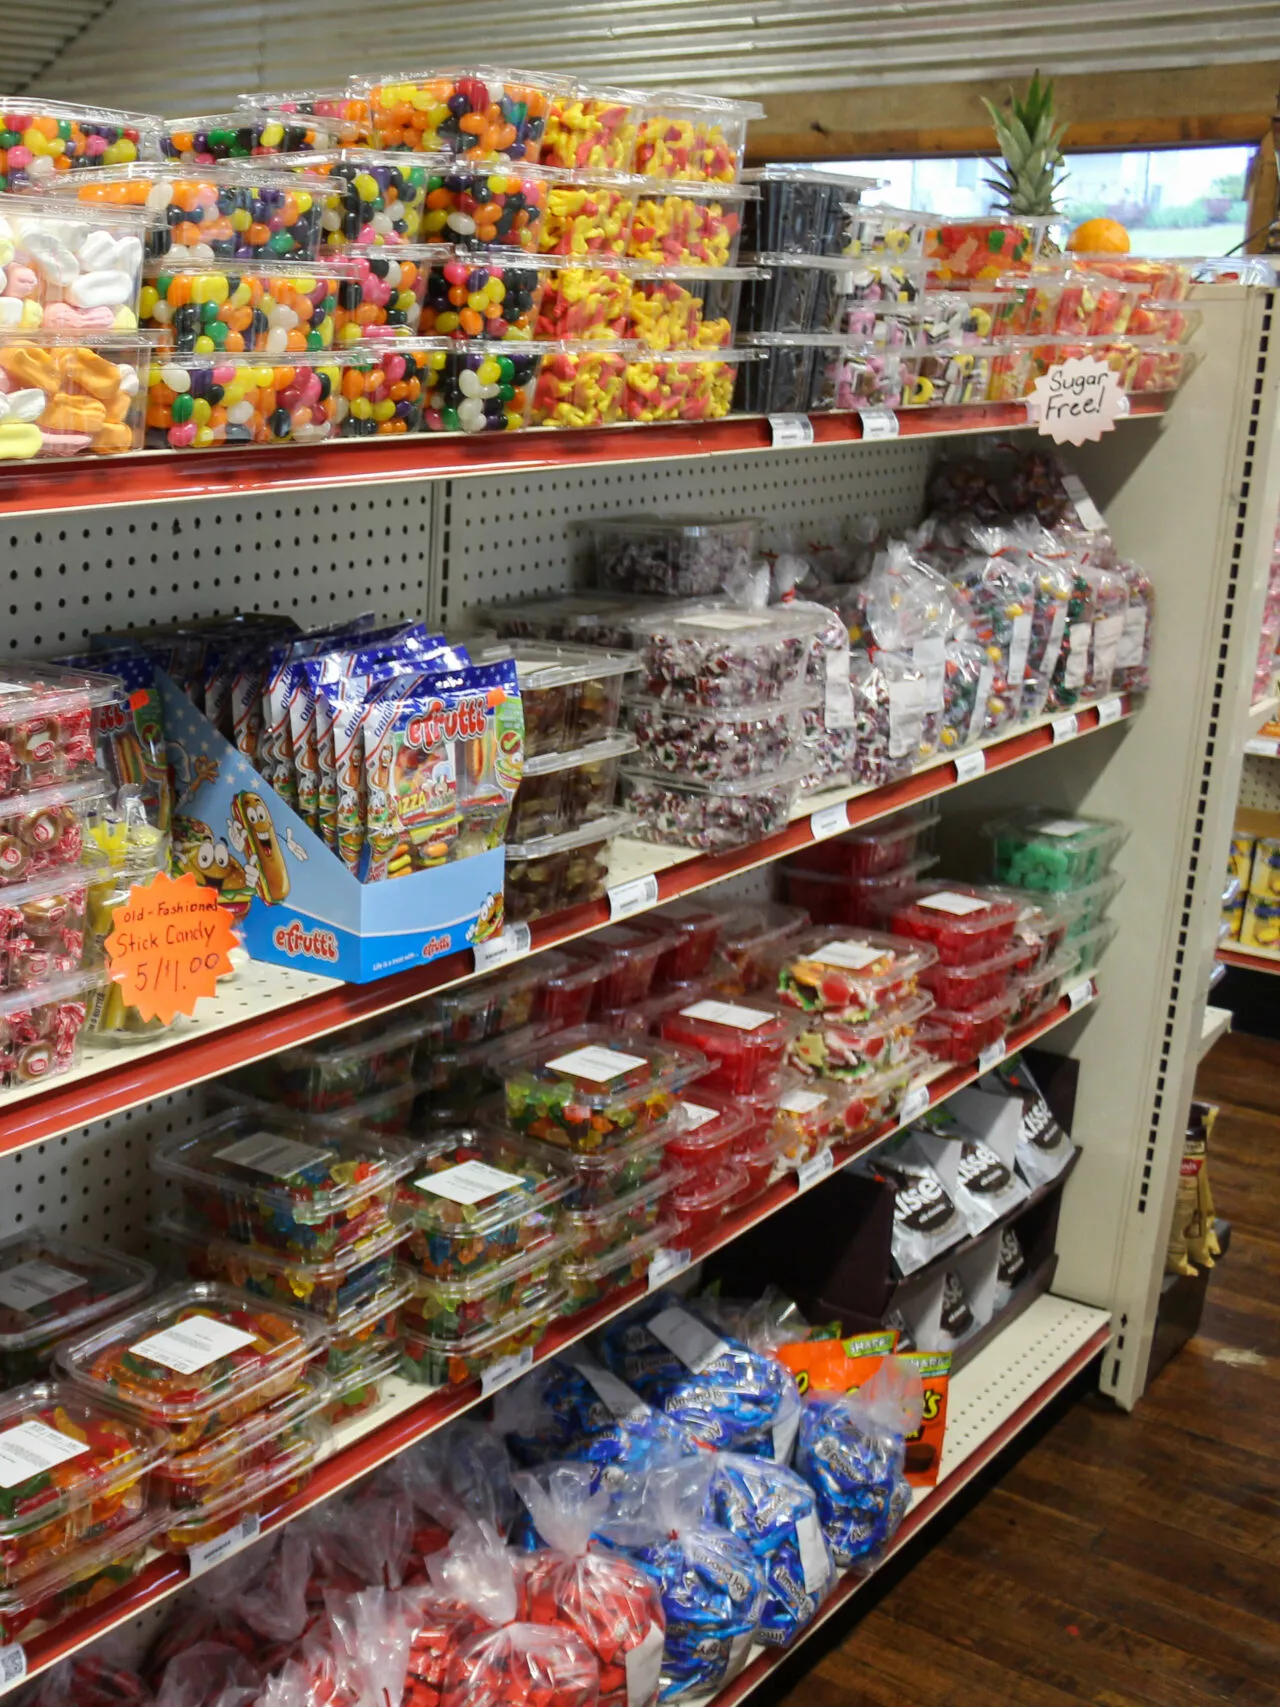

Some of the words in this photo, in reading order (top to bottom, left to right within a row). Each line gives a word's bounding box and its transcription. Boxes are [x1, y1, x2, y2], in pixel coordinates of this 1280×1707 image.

[1049, 370, 1109, 396] Sugar
[1045, 386, 1106, 420] Free!
[407, 697, 488, 752] efrutti
[116, 932, 158, 958] Stick
[166, 921, 216, 948] Candy
[274, 921, 338, 961] efrutti
[422, 935, 452, 958] efrutti
[666, 1391, 711, 1413] Almond
